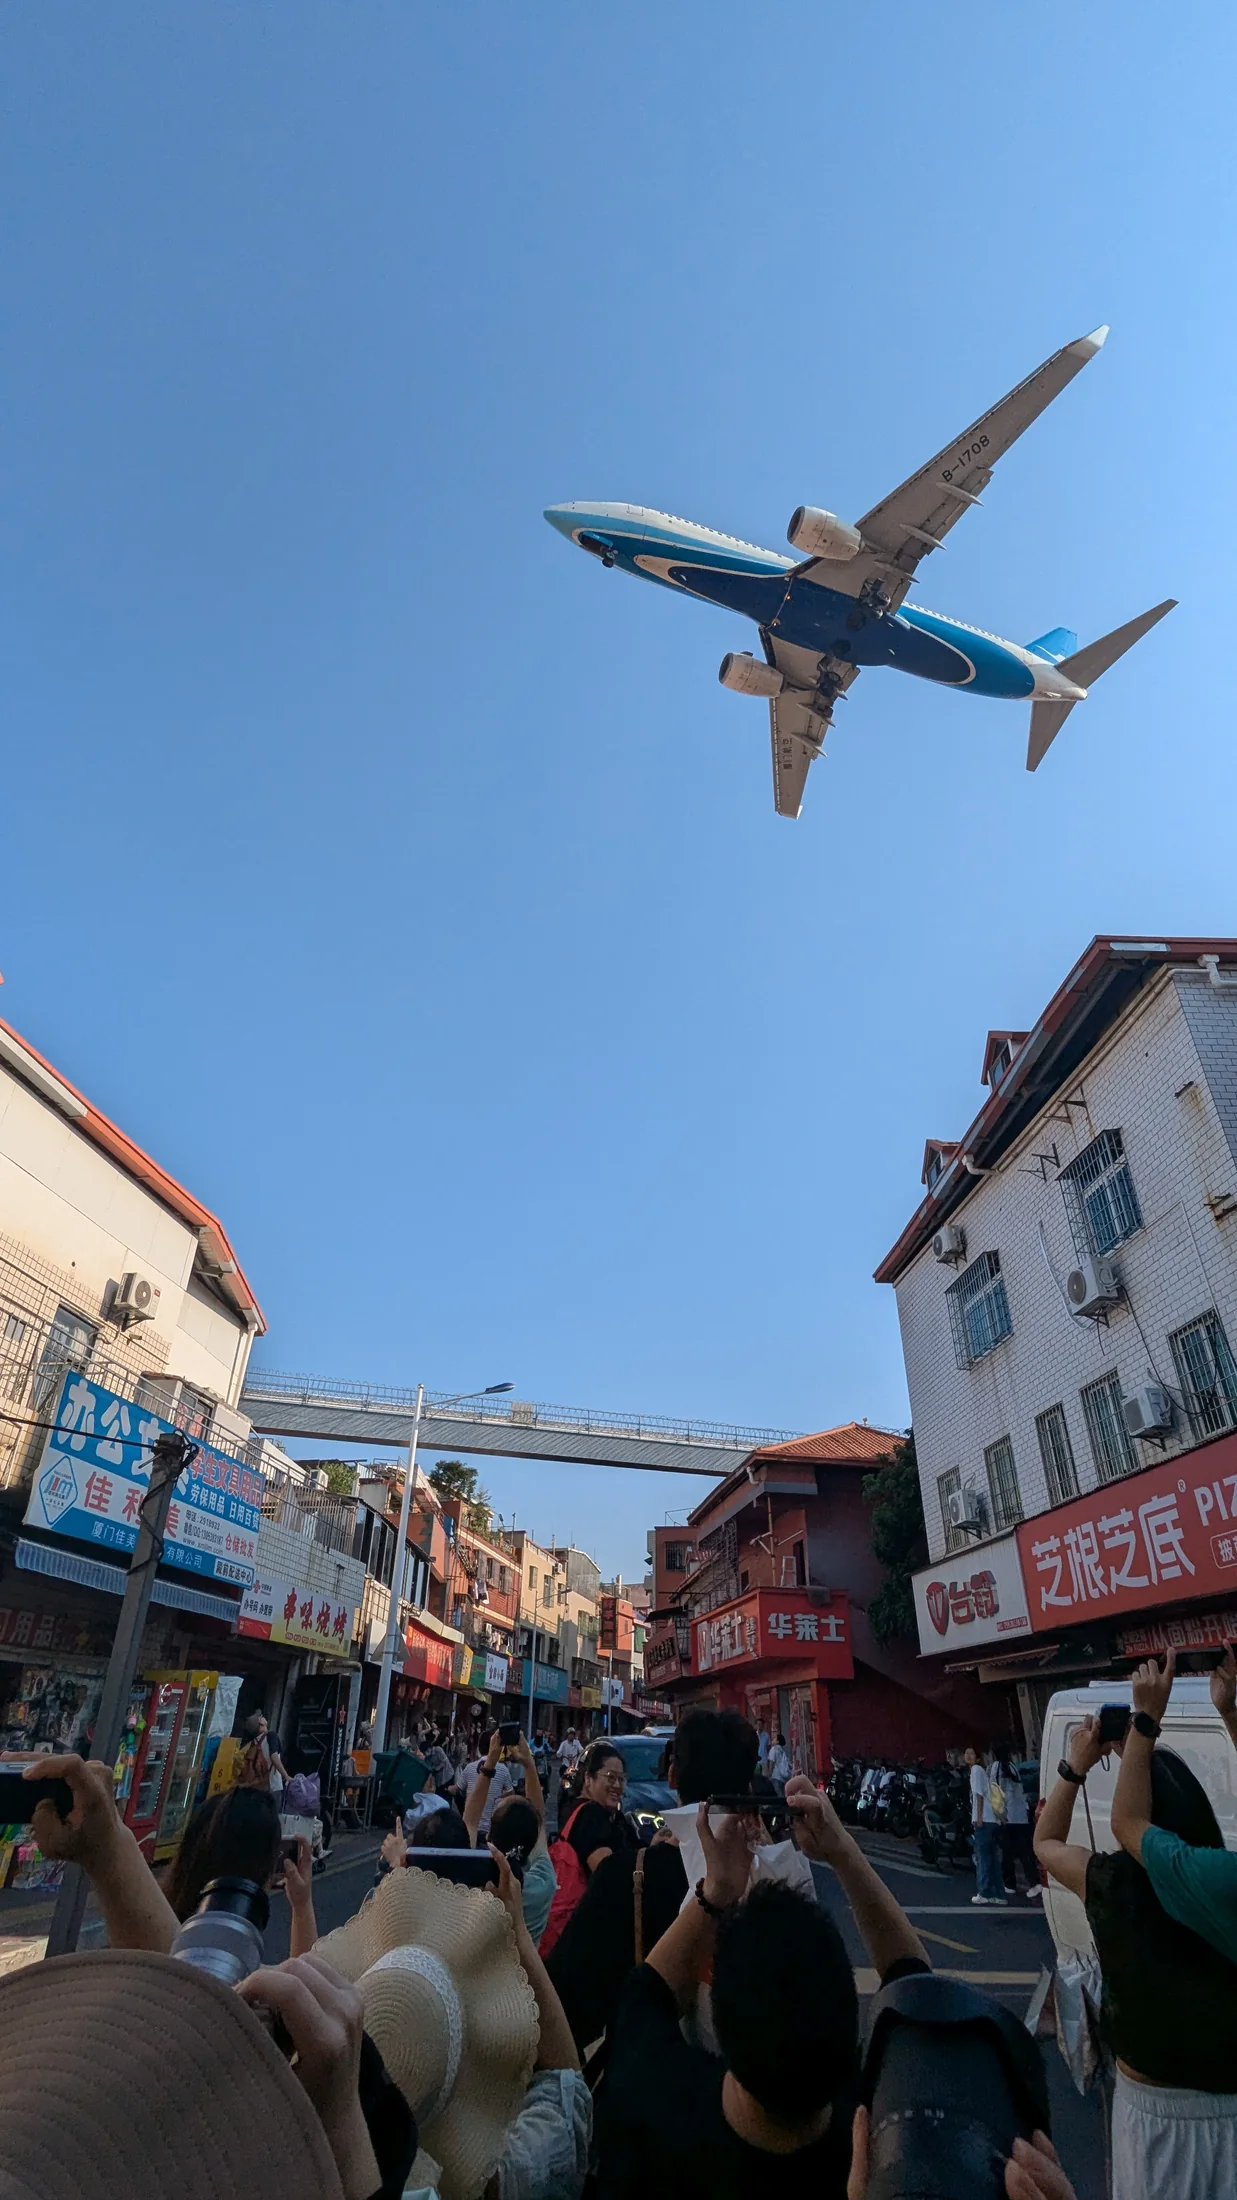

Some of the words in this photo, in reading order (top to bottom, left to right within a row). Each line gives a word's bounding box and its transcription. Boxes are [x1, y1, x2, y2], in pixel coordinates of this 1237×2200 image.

[942, 435, 990, 483] B-1708
[190, 1446, 262, 1509] 学生文具用品
[190, 1484, 225, 1516] 劳保用品
[225, 1532, 254, 1559] 仓储批发
[1031, 1491, 1196, 1612] 芝根芝底
[767, 1612, 845, 1643] 华莱士
